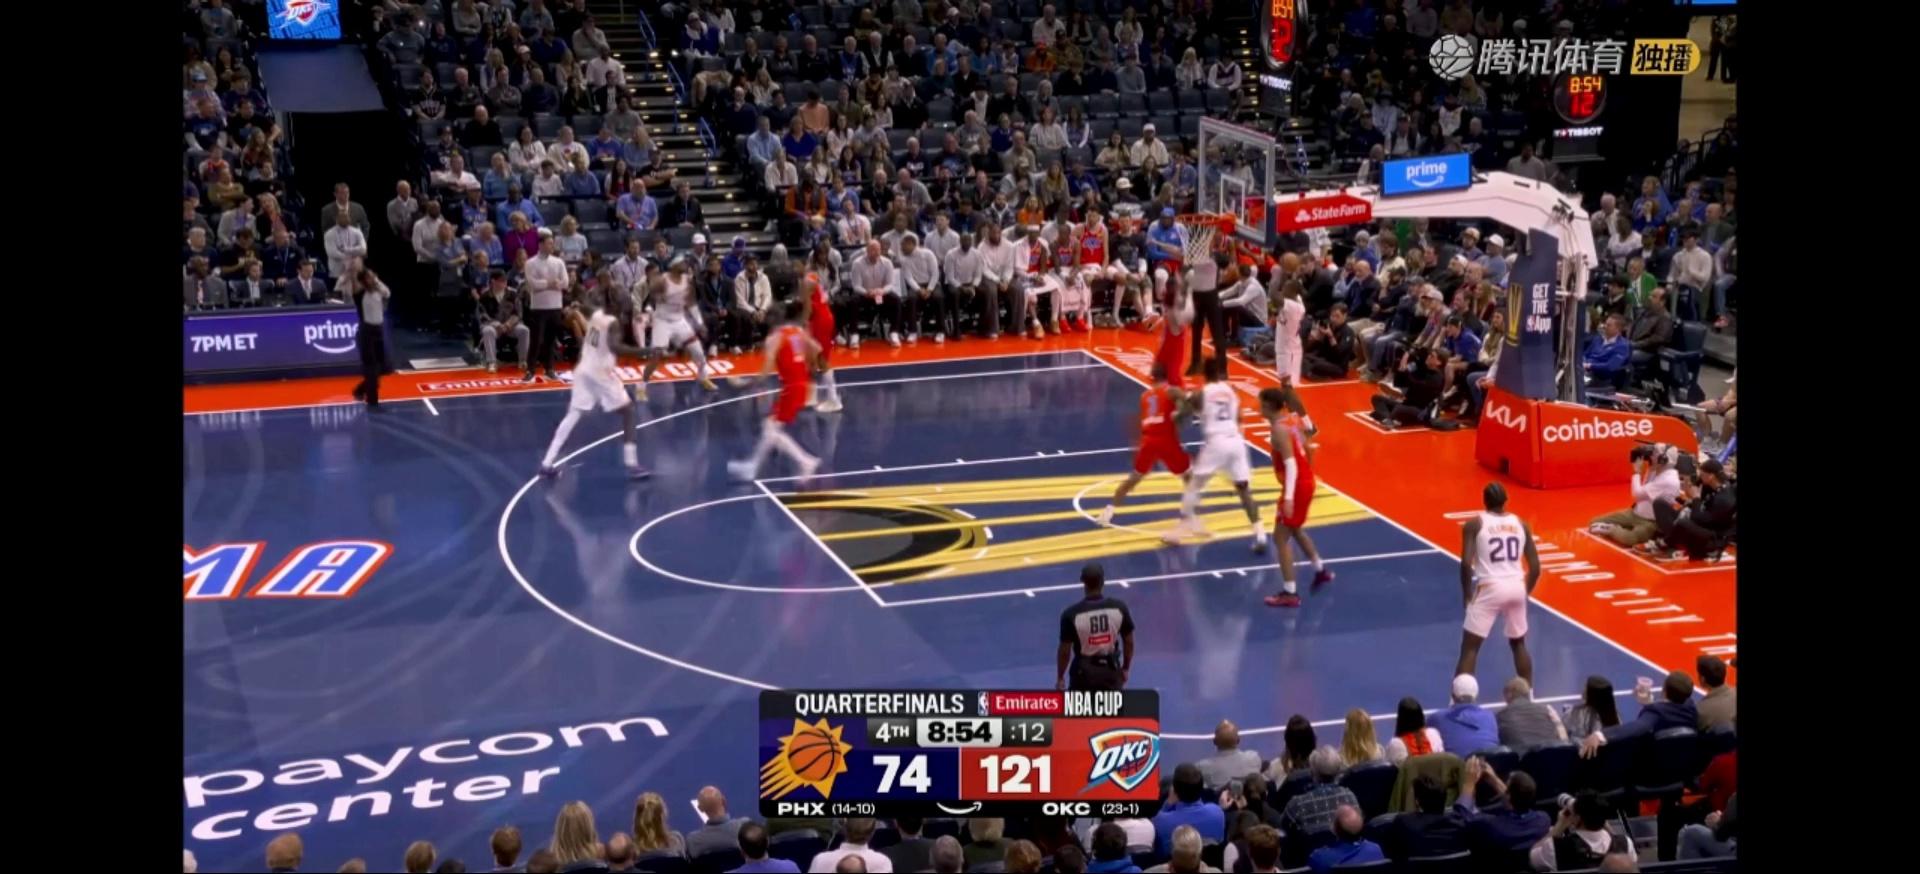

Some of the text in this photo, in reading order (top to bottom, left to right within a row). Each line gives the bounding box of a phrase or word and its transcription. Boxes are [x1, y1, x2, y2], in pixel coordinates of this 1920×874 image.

[1570, 76, 1602, 93] 8:54
[1572, 95, 1594, 116] 12
[1406, 161, 1447, 181] prime
[1532, 283, 1550, 299] GET
[1532, 300, 1549, 314] THE
[1536, 315, 1551, 334] App
[1543, 416, 1653, 443] coinbase
[1488, 536, 1520, 563] 20
[1090, 614, 1109, 634] 60
[183, 715, 669, 807] paycom
[191, 765, 561, 840] center
